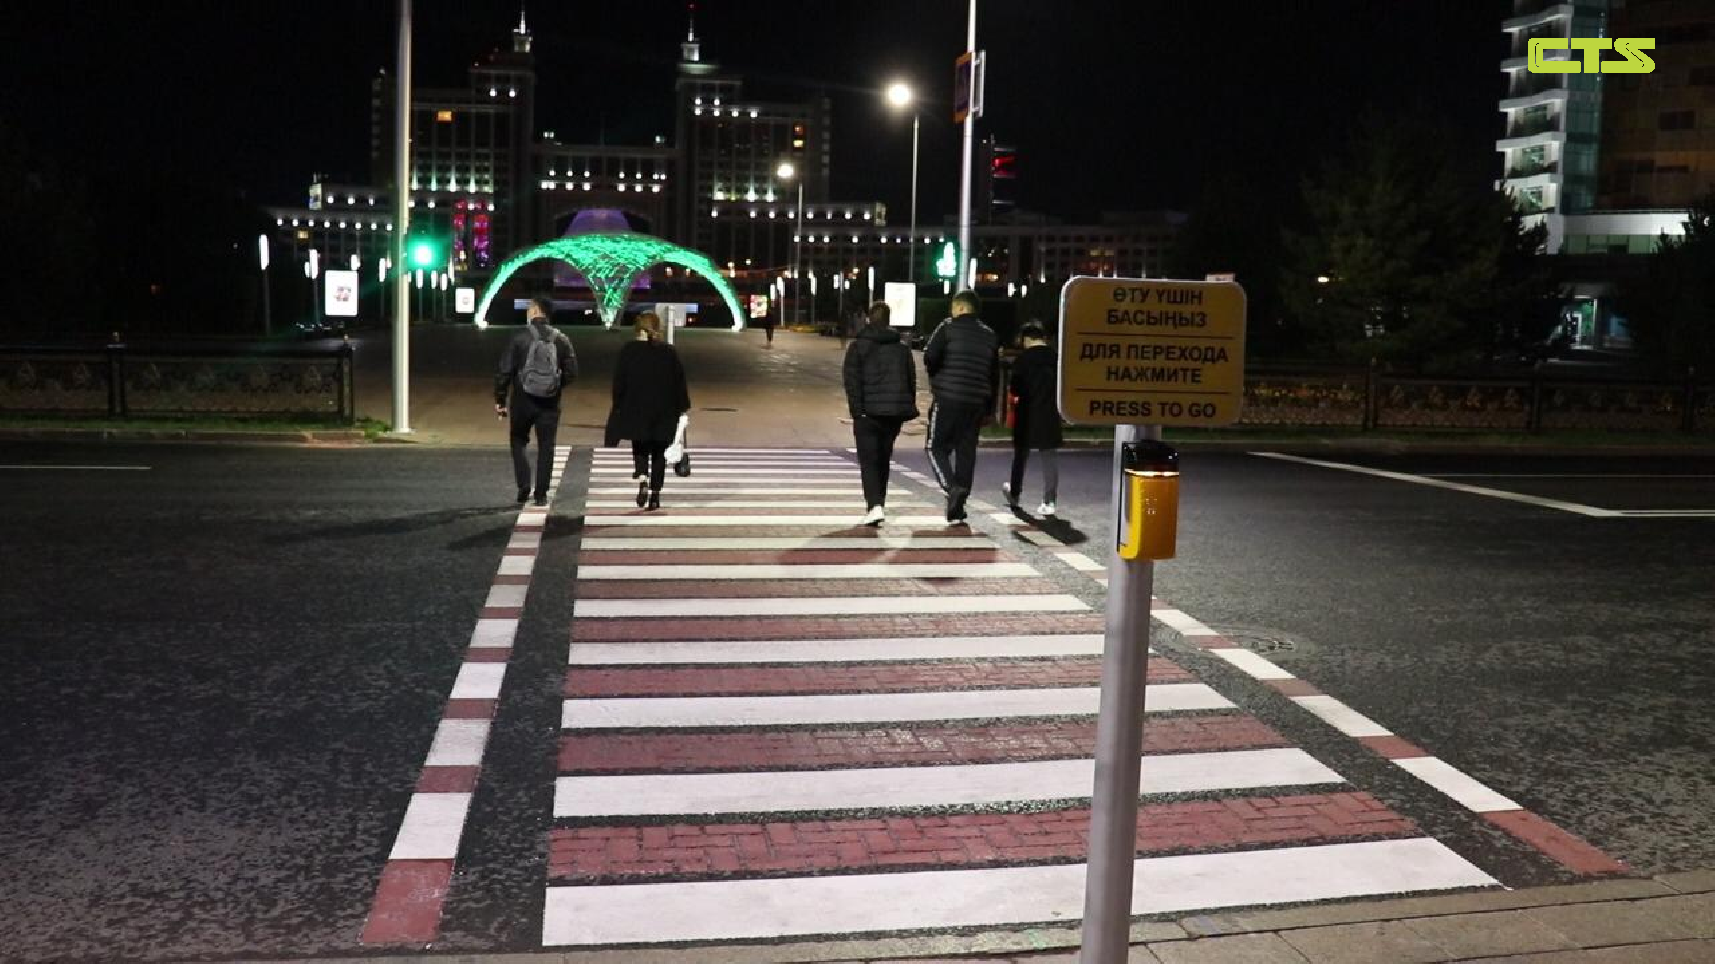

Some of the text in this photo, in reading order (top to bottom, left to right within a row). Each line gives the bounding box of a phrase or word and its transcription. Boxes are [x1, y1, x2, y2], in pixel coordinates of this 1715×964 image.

[1113, 288, 1202, 305] ӨТУ ҮШІН
[1107, 309, 1206, 329] БАСЫҢЫЗ
[1080, 343, 1228, 364] ДЛЯ ПЕРЕХОДА
[1107, 367, 1201, 383] НАЖМИТЕ
[1090, 400, 1216, 418] PRESS TO GO
